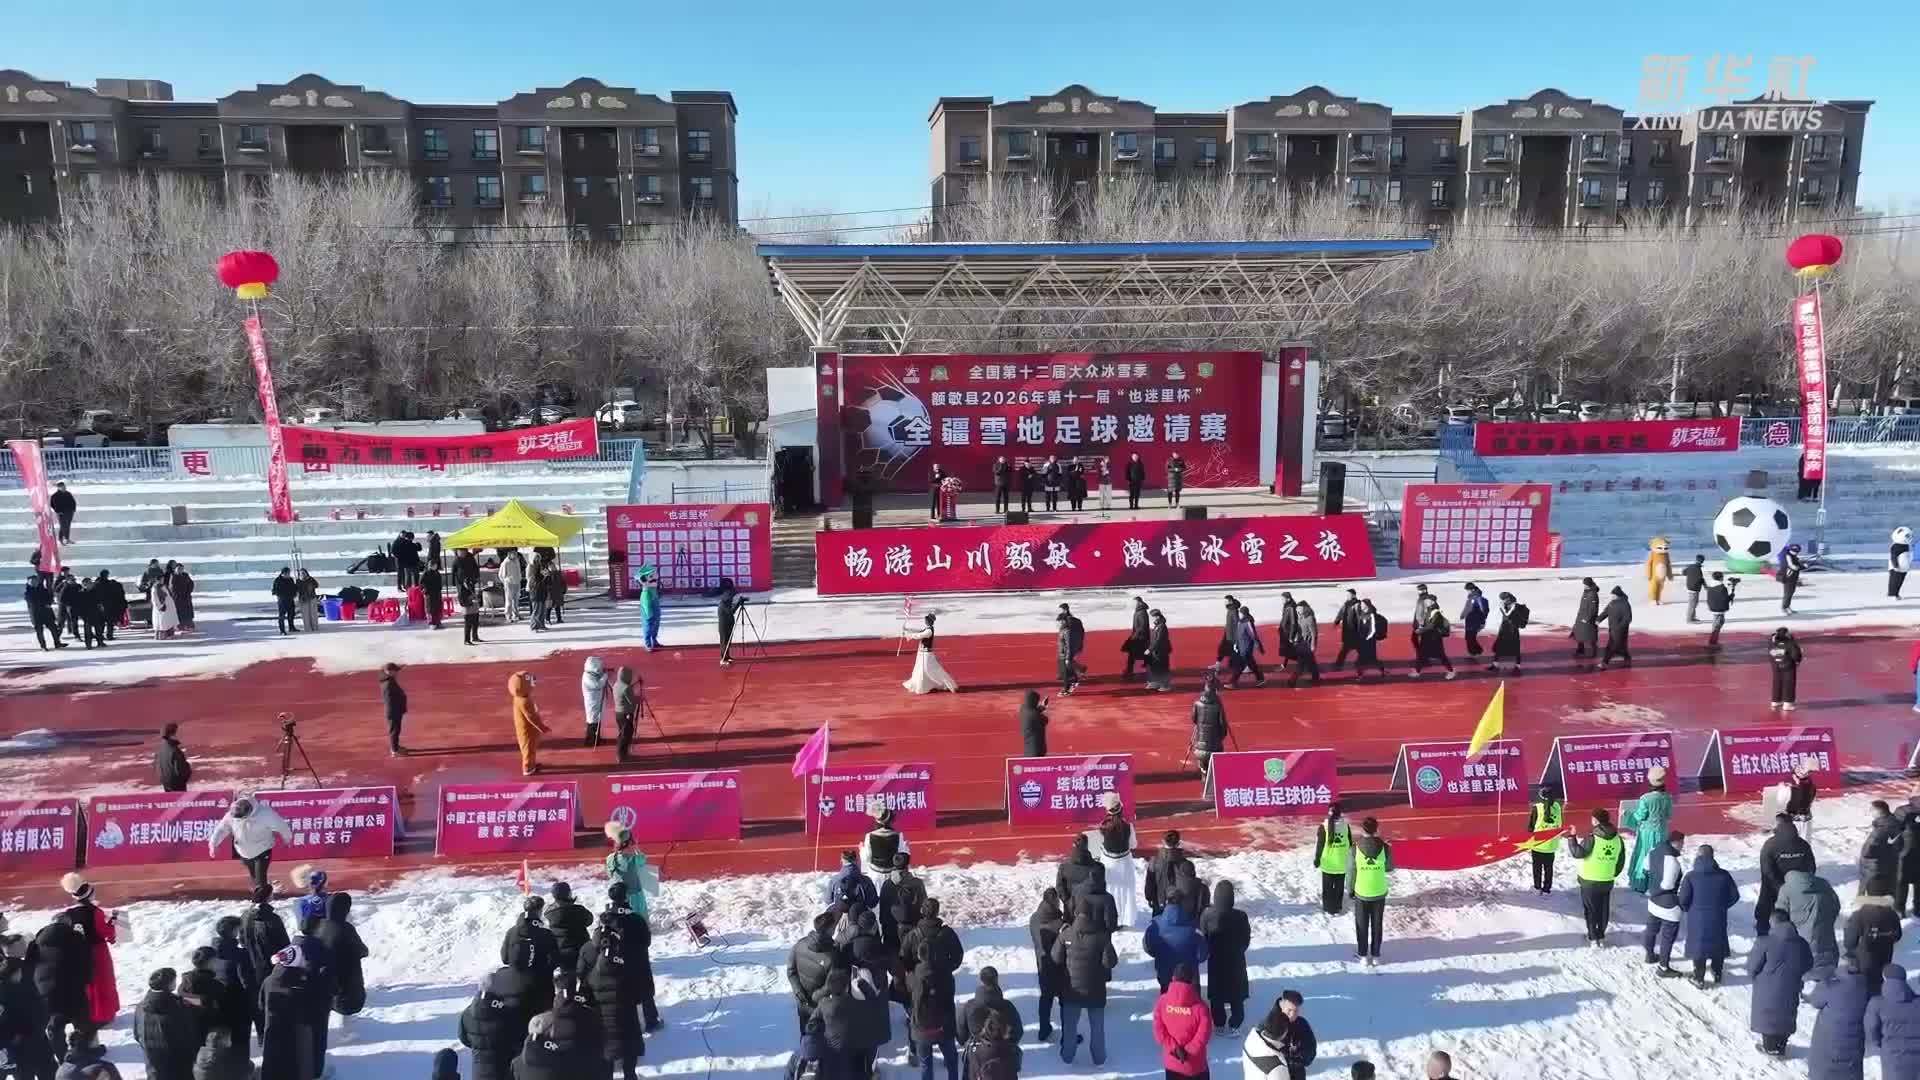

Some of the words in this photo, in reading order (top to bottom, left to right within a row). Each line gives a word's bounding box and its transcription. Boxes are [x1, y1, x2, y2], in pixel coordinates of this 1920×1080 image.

[968, 363, 1148, 380] 全国第十二届大众冰雪季
[903, 412, 1228, 447] 全疆雪地足球邀请赛
[1765, 422, 1791, 447] 德
[180, 450, 211, 476] 更
[1463, 763, 1498, 777] 额敏县
[1056, 775, 1115, 792] 塔城地区
[1447, 777, 1518, 793] 也迷里足球队
[1050, 793, 1108, 810] 足协代表
[1223, 784, 1332, 808] 额敏县足球协会
[446, 808, 568, 825] 中国工商银行股份有限公司
[130, 819, 220, 845] 托里天山小哥足球
[477, 824, 535, 839] 额敏支行
[1166, 1005, 1192, 1016] CHINA
